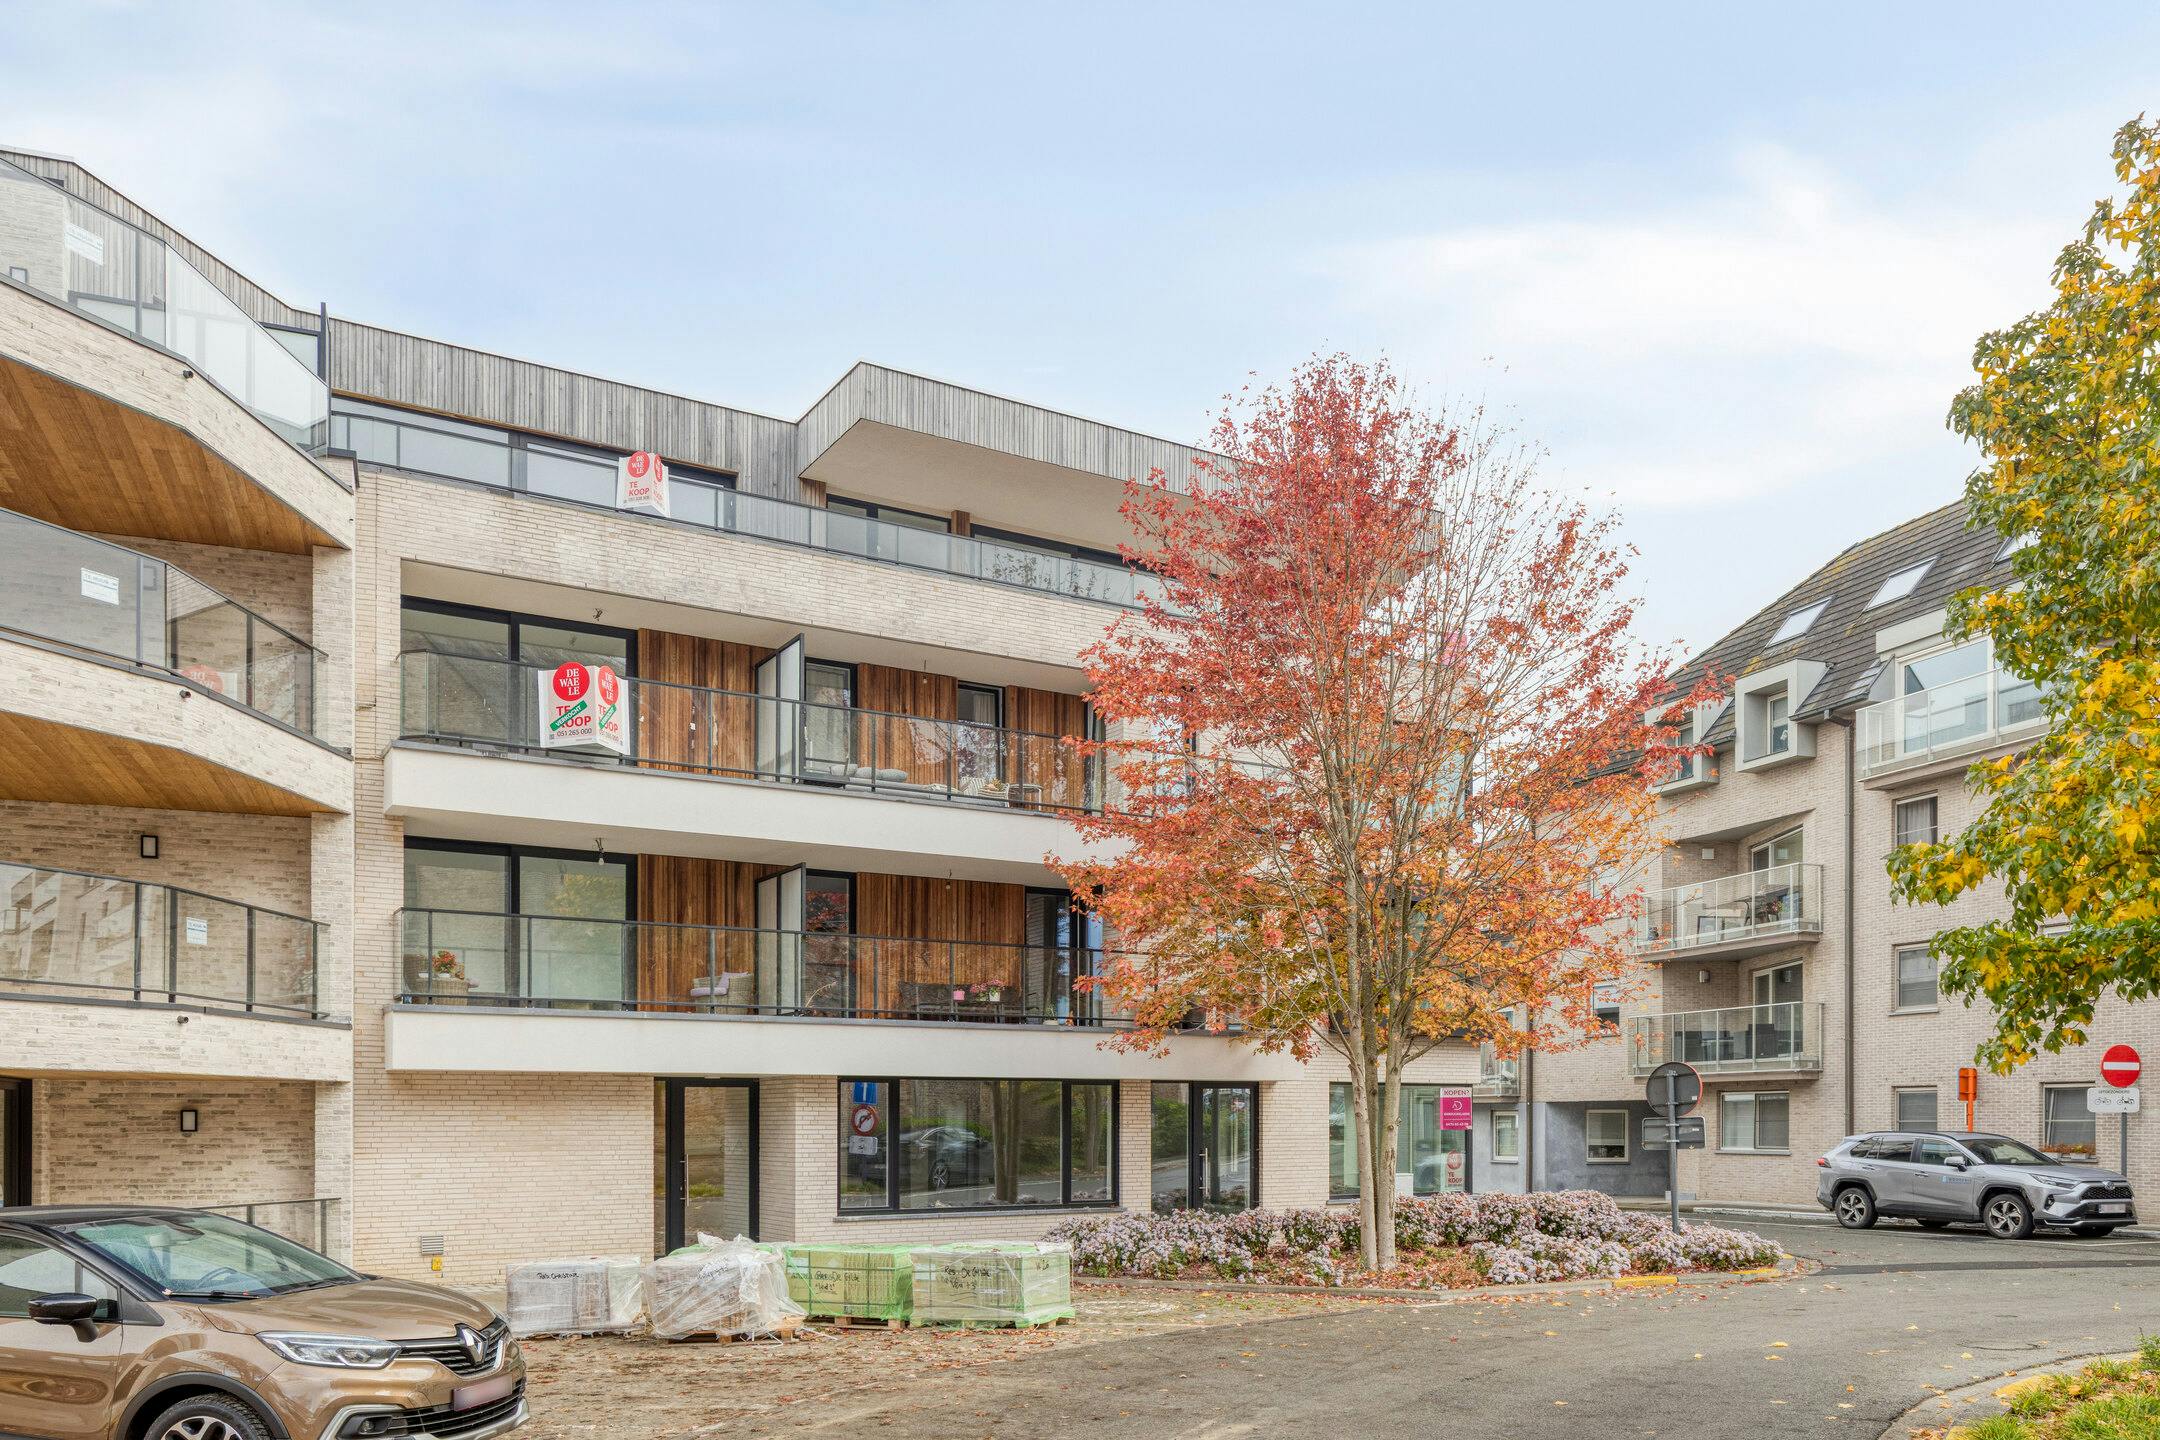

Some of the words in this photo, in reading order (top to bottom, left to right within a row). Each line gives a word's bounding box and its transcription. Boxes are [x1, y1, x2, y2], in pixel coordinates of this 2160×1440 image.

[628, 488, 649, 496] KOOP
[566, 668, 580, 677] DE
[559, 677, 580, 687] WAE
[568, 686, 580, 696] LE
[556, 705, 571, 716] TE
[555, 705, 581, 727] VERKOCHT
[560, 716, 592, 729] OOP
